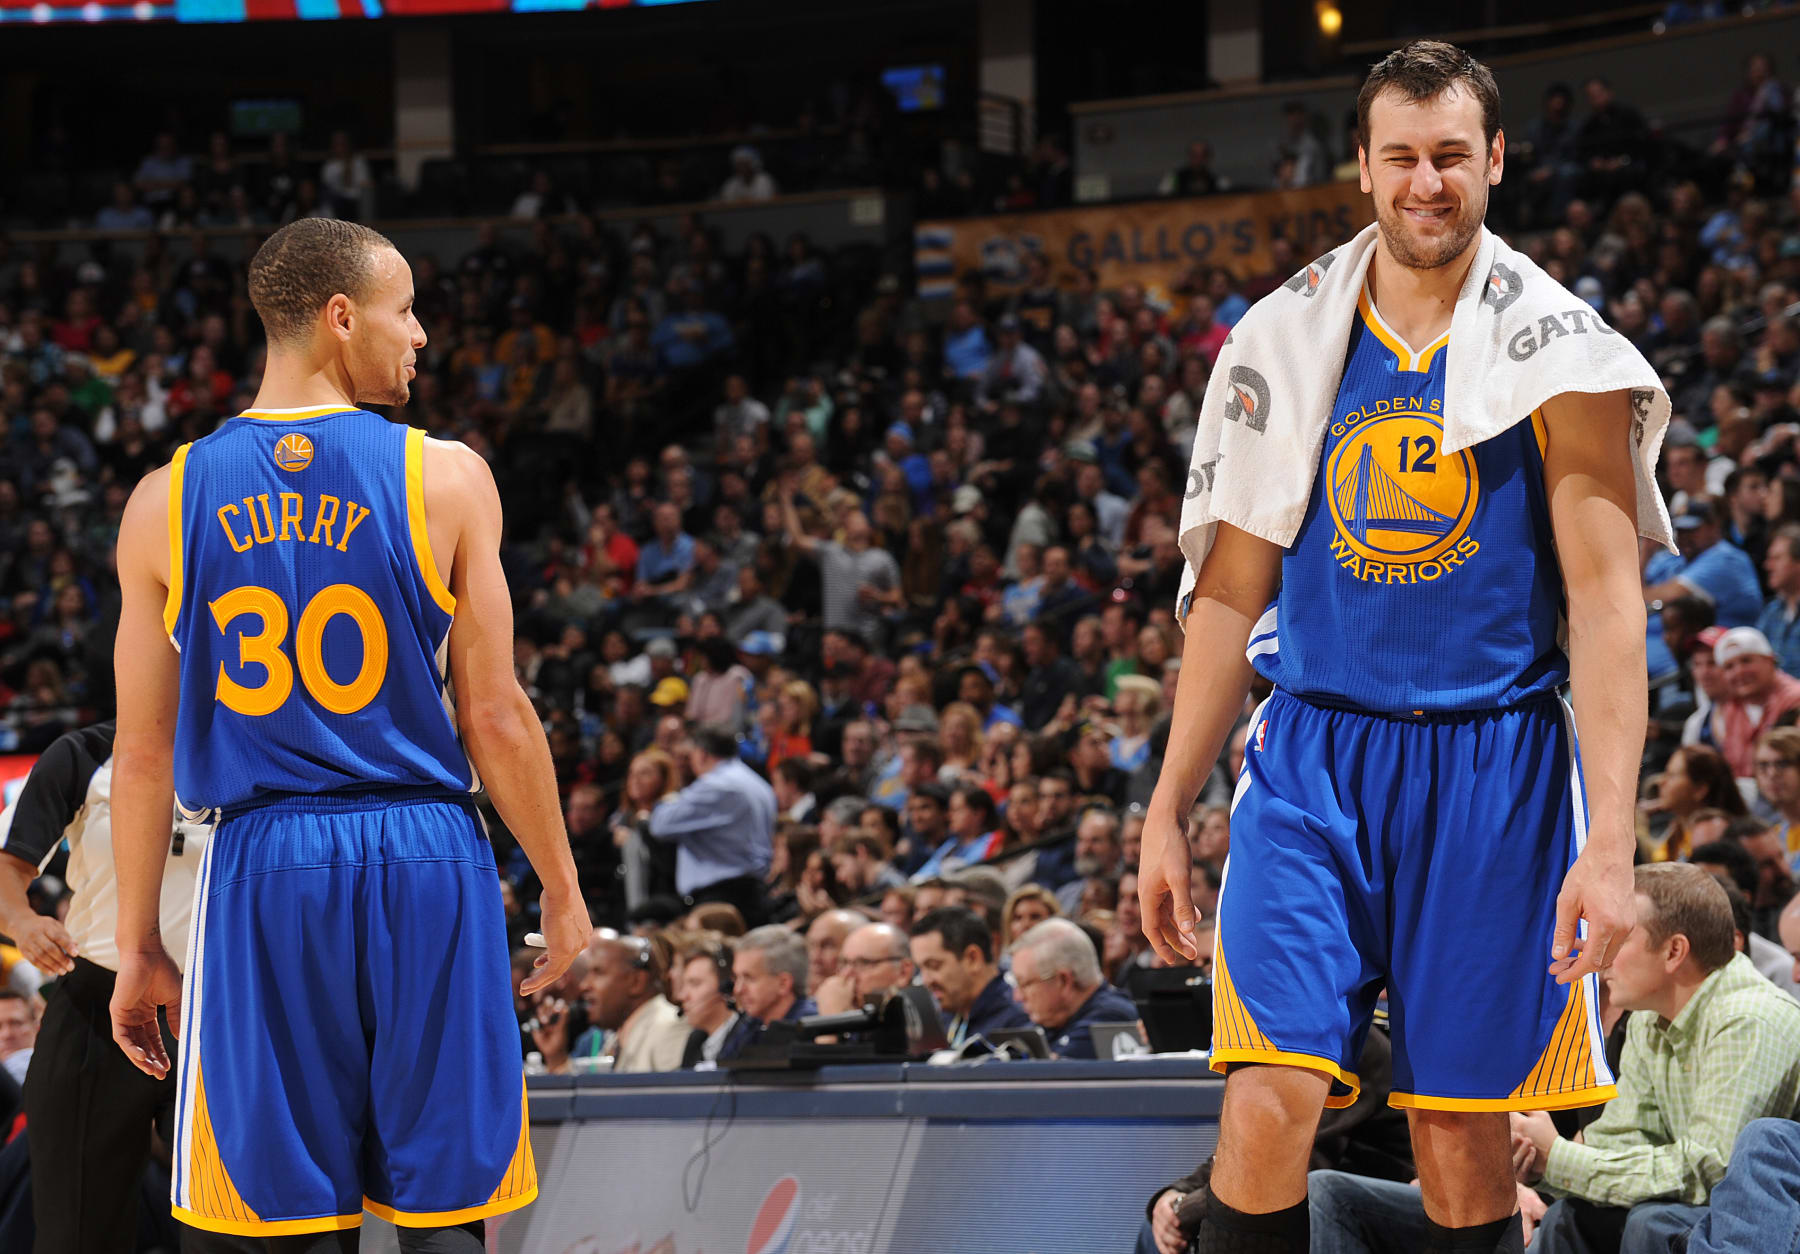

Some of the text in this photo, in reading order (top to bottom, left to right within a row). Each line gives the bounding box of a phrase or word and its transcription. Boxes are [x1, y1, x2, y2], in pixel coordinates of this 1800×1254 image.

[1067, 217, 1256, 270] GALLO'S
[1330, 396, 1423, 437] GOLDEN
[1397, 435, 1437, 474] 12
[217, 492, 370, 553] CURRY
[1329, 528, 1481, 585] WARRIORS
[207, 583, 389, 716] 30
